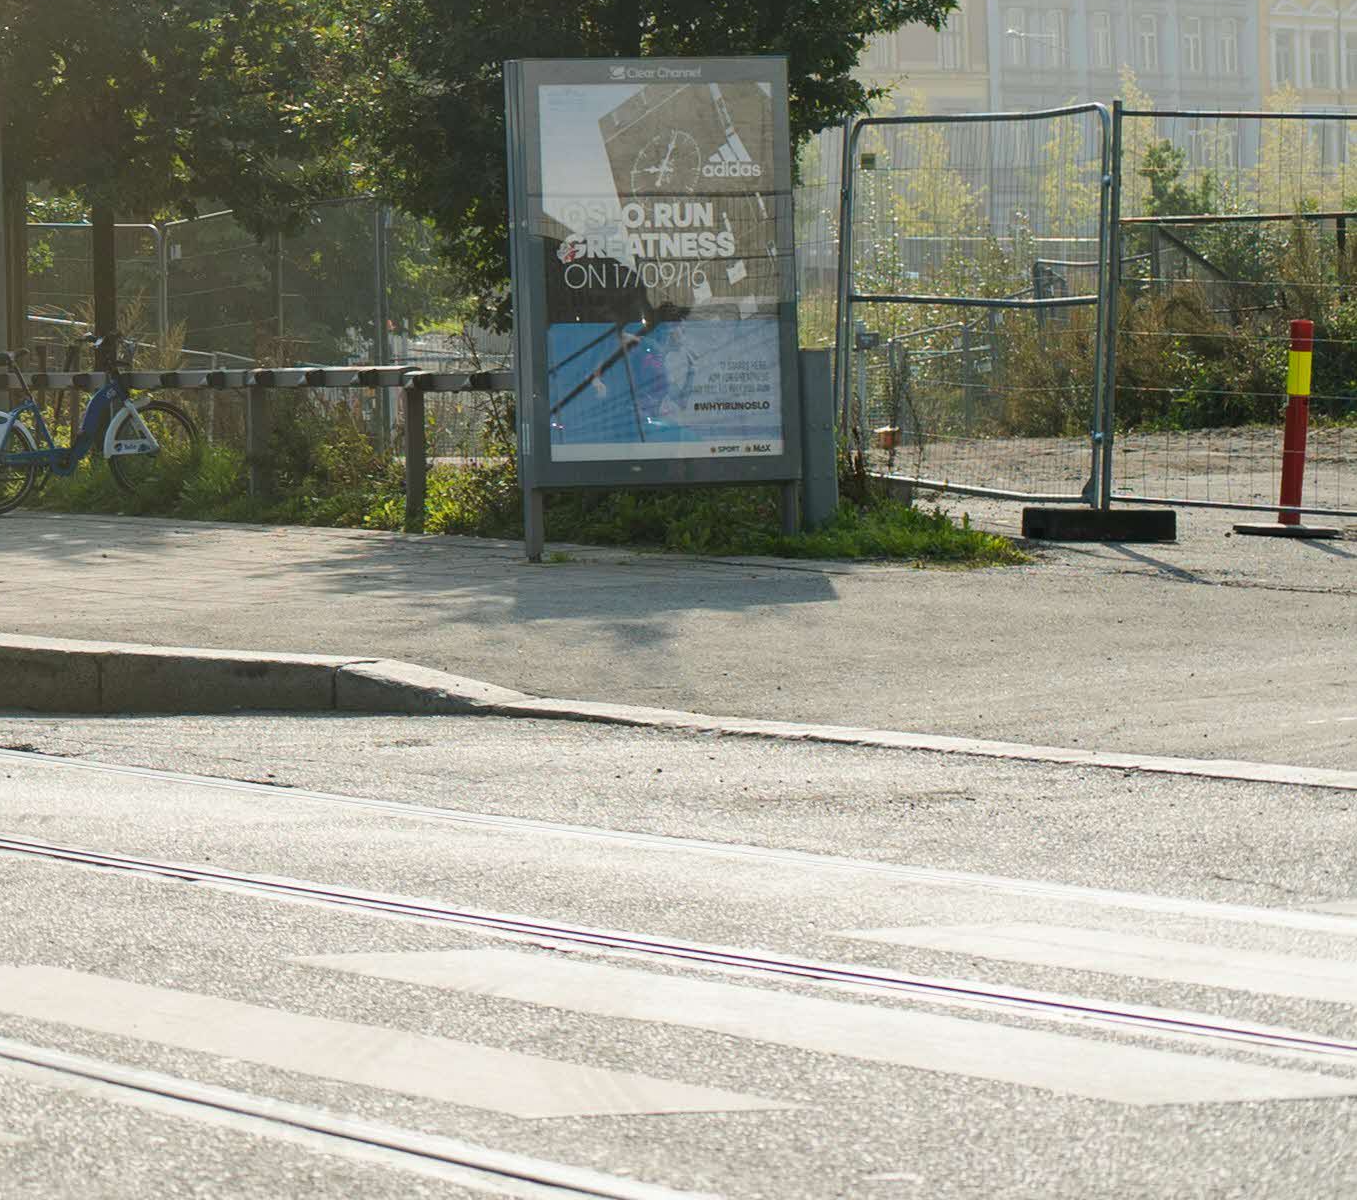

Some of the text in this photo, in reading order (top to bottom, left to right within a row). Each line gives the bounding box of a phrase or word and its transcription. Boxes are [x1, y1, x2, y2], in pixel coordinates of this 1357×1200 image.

[627, 65, 702, 79] Clear Channel
[702, 161, 762, 177] adidas
[560, 231, 735, 259] GREATNESS
[565, 263, 607, 290] ON
[753, 443, 772, 453] MAX
